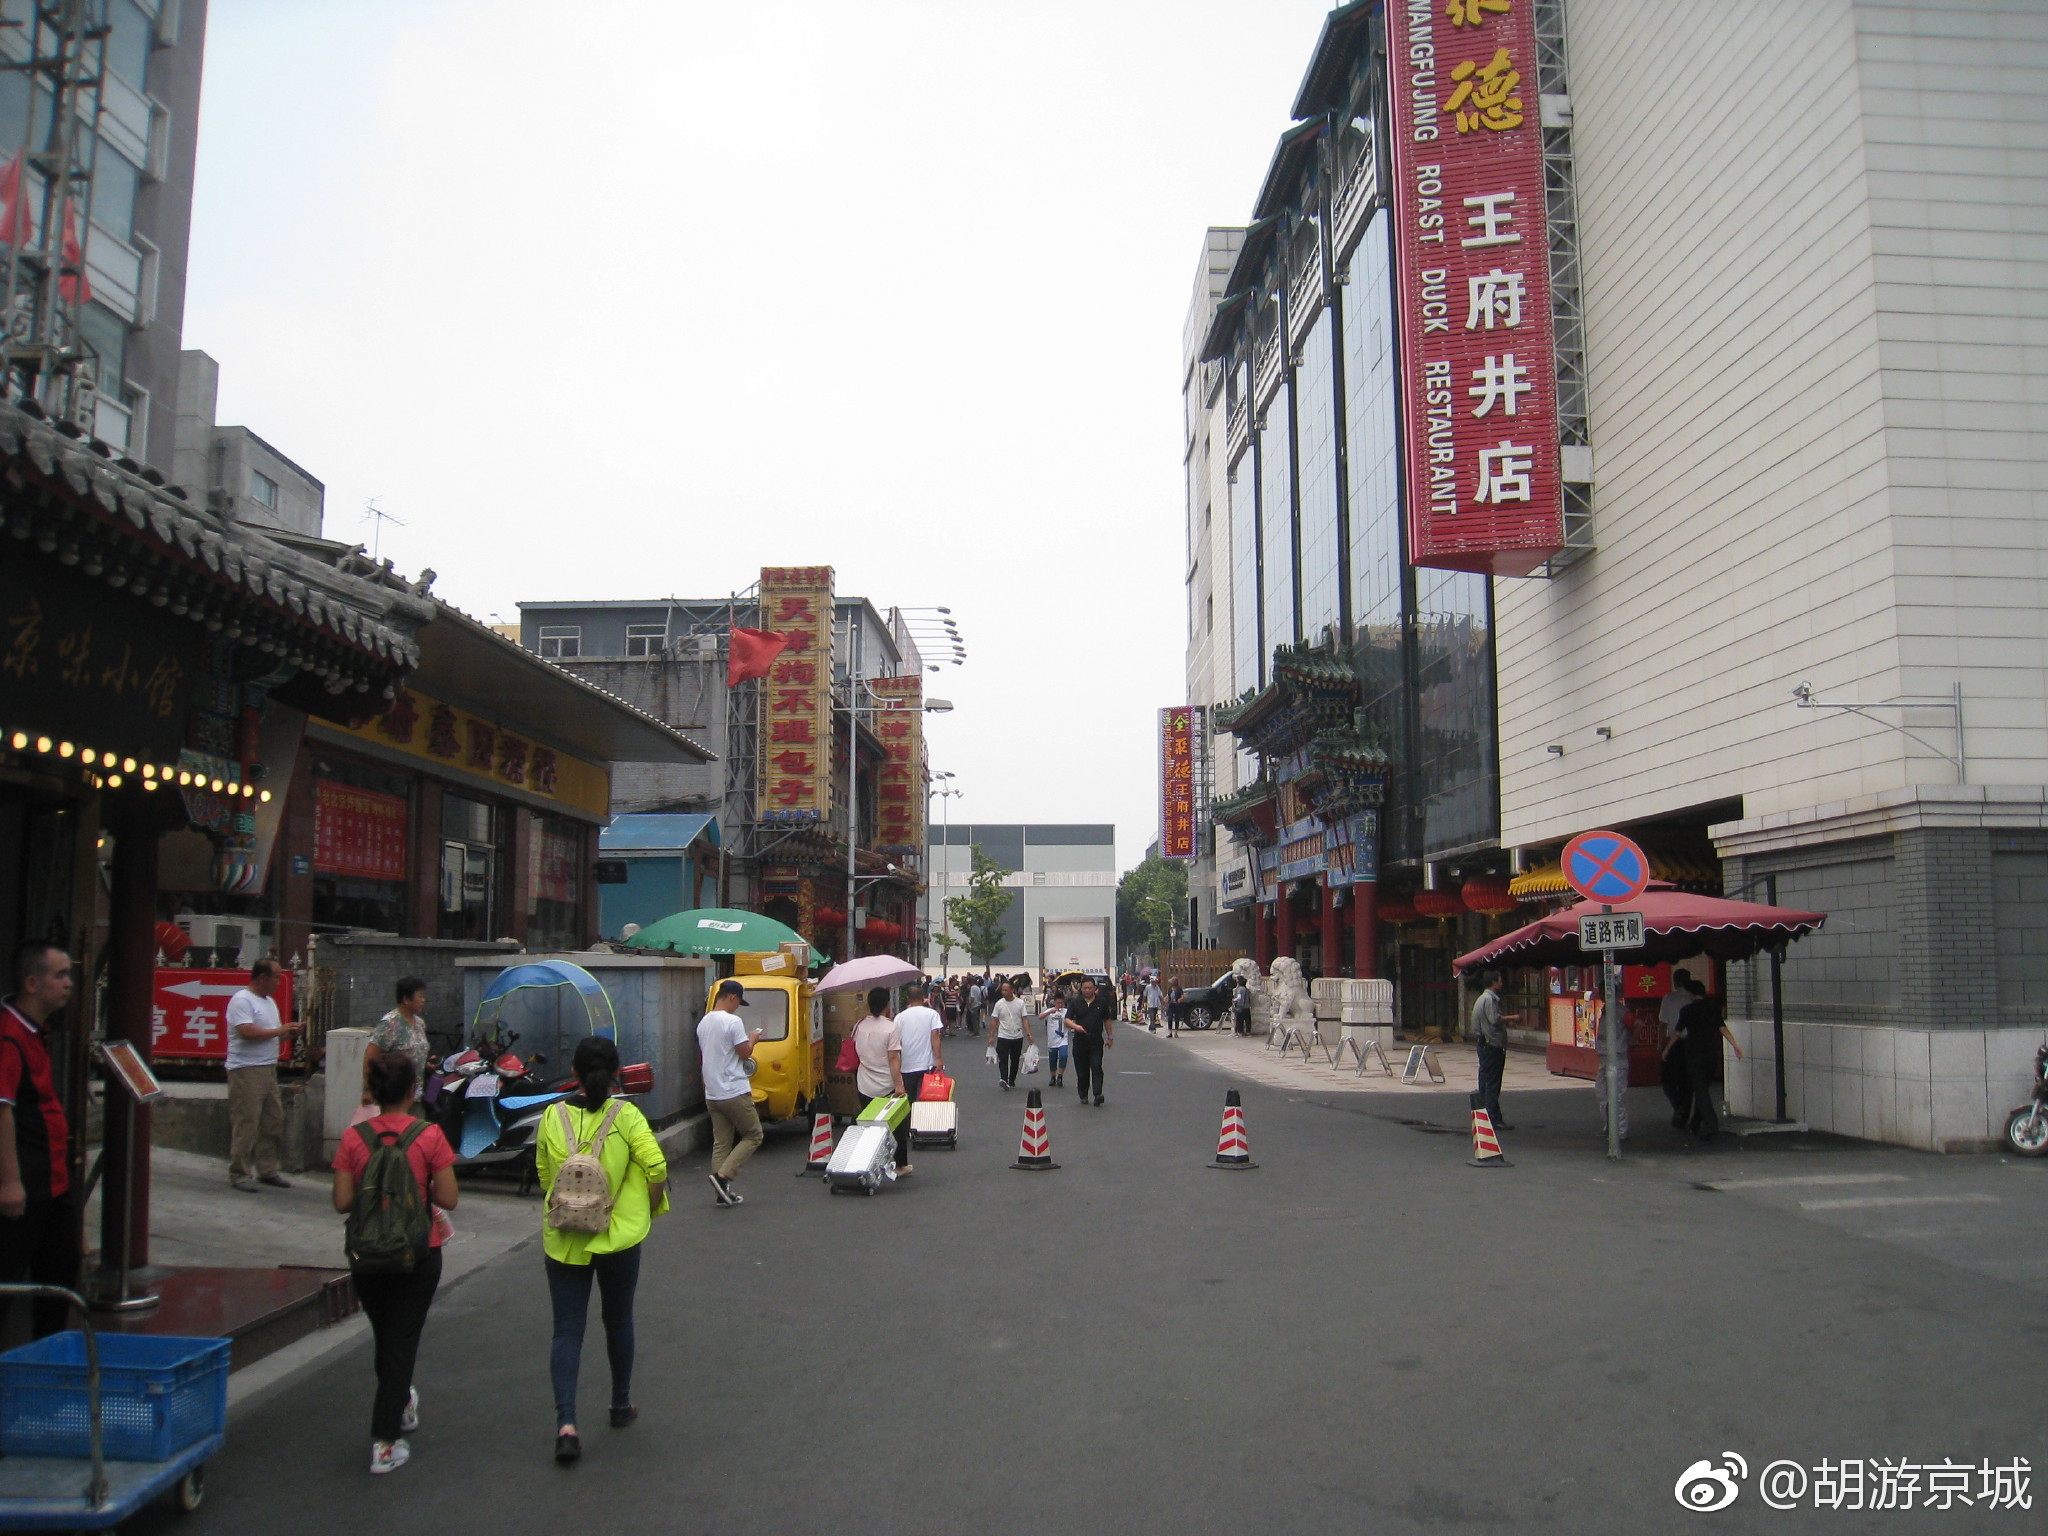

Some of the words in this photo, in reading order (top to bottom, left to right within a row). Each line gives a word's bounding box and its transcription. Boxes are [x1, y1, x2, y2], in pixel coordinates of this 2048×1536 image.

[1407, 0, 1439, 143] WANGFUJING
[1416, 164, 1445, 243] ROAST
[1421, 268, 1449, 333] DUCK
[1461, 192, 1533, 504] 王府井店
[1425, 361, 1457, 515] RESTAURANT
[770, 598, 816, 805] 天津狗不理包子
[1173, 714, 1190, 849] 全聚德王府井店
[1584, 918, 1640, 944] 道路两侧
[1639, 974, 1656, 993] 亭
